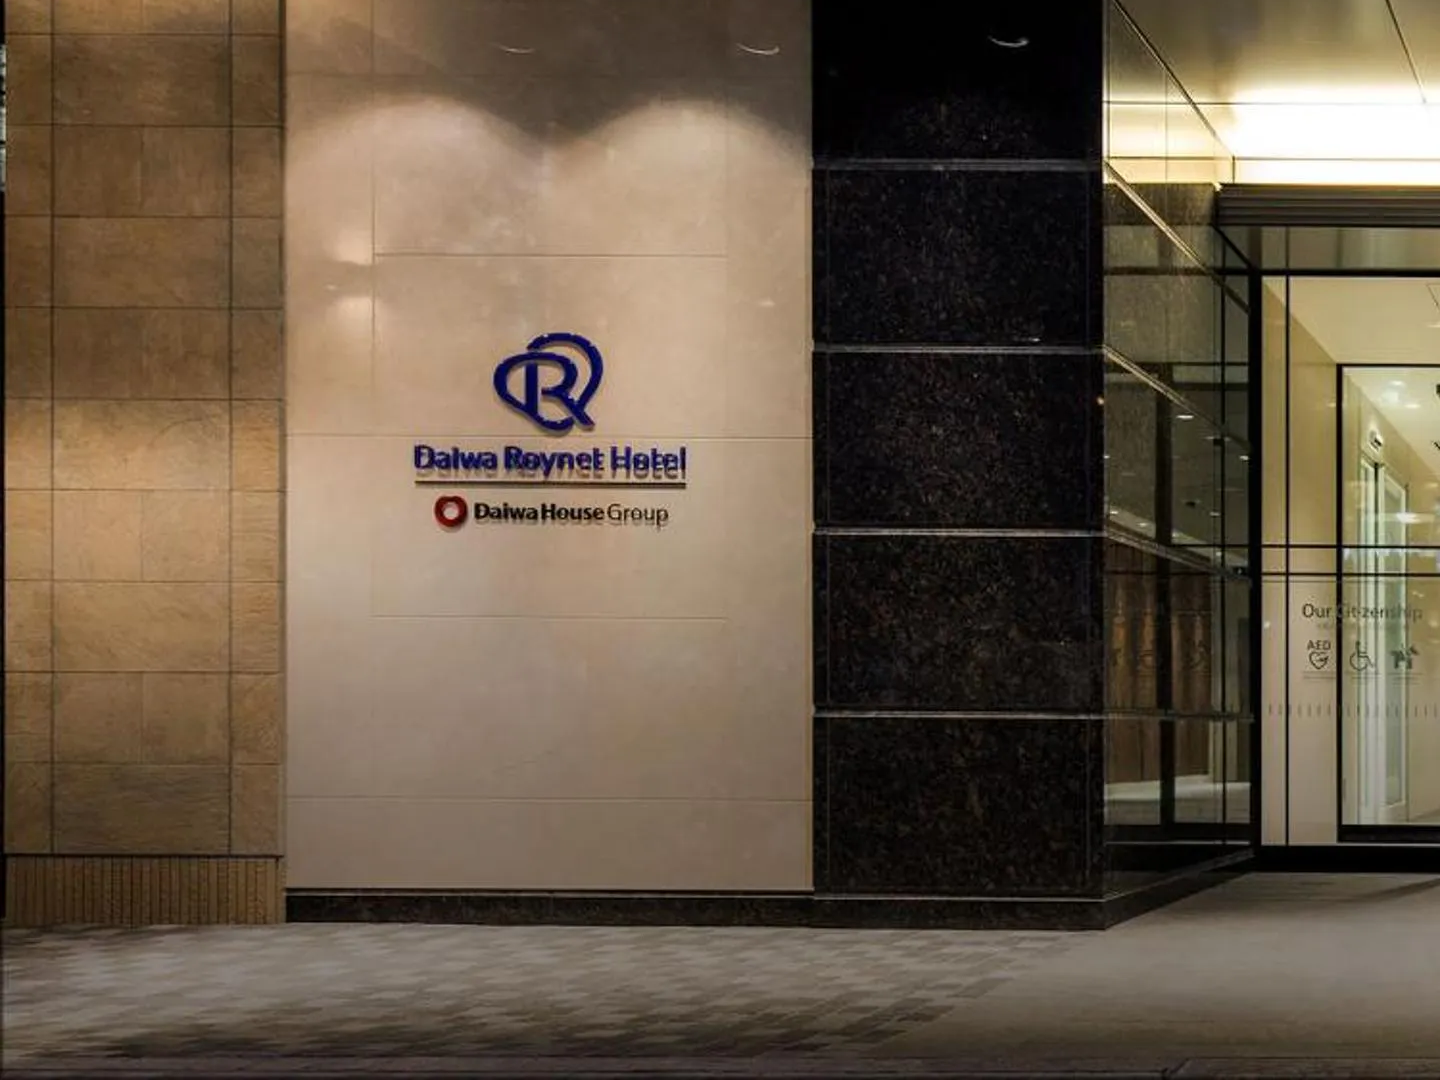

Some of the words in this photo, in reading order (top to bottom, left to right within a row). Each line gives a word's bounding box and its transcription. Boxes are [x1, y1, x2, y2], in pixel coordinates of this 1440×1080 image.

[414, 444, 498, 472] Daiwa
[503, 445, 602, 479] Roynet
[610, 446, 687, 473] Hotel
[474, 503, 538, 521] Daiwa
[541, 503, 604, 521] House
[607, 504, 669, 526] Group
[1302, 603, 1332, 619] Our
[1307, 639, 1331, 651] AED
